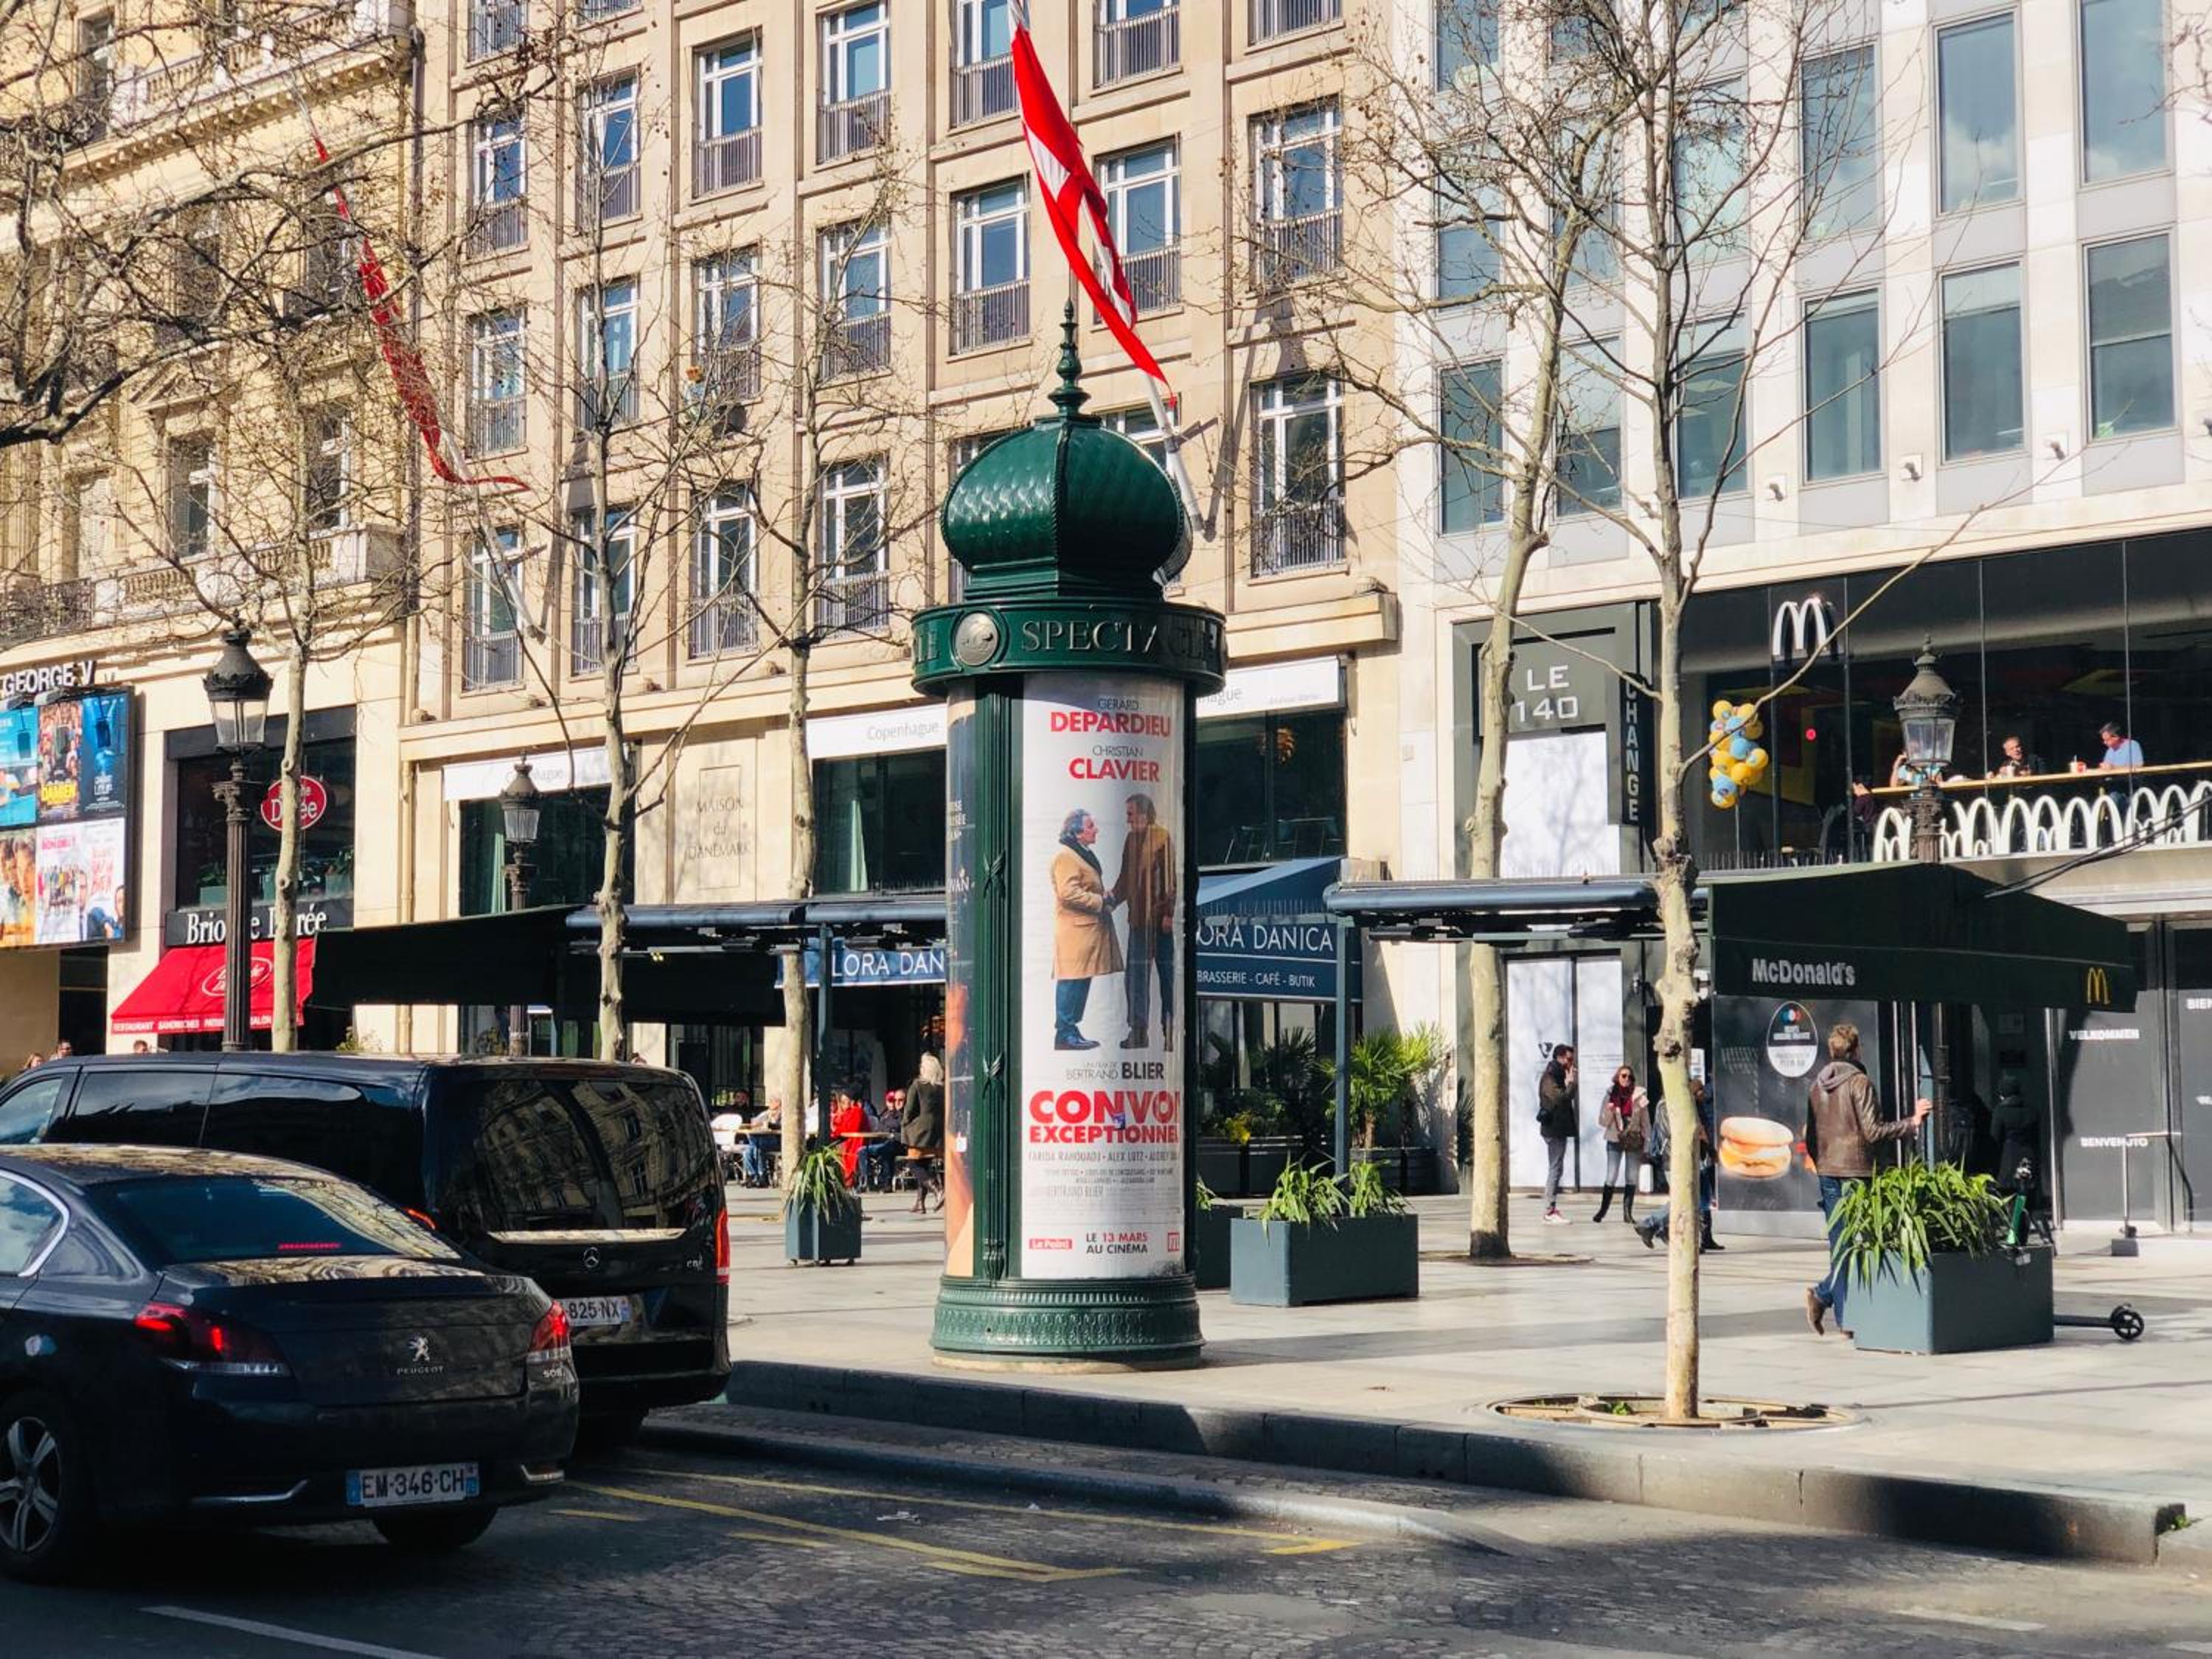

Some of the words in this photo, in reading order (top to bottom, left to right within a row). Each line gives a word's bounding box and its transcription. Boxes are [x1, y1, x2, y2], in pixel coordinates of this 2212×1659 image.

[4, 666, 74, 695] GEORGE
[81, 660, 94, 686] V
[1527, 664, 1570, 691] LE
[1512, 695, 1579, 723] 140
[866, 720, 939, 742] Copenhague
[1051, 712, 1172, 737] DEPARDIEU
[1092, 745, 1143, 757] CHRISTIAN
[1626, 678, 1640, 821] CHANGE
[1068, 757, 1161, 782] CLAVIER
[696, 796, 743, 814] MAISON
[713, 821, 726, 835] du
[186, 911, 260, 945] Brioe
[268, 903, 327, 939] rée
[1254, 925, 1334, 952] DANICA
[832, 950, 891, 978] LORA
[900, 950, 945, 975] DAN
[1752, 958, 1856, 986] McDonald's
[1197, 970, 1248, 984] BRASSERIE
[1256, 971, 1281, 986] CAFÉ
[1289, 974, 1315, 987] BUTIK
[1066, 1069, 1119, 1080] BERTRAND
[1121, 1062, 1165, 1080] BLIER
[1086, 1233, 1098, 1243] LE
[1103, 1233, 1115, 1243] 13
[1119, 1232, 1148, 1242] MARS
[1086, 1244, 1103, 1254] AU
[397, 1366, 445, 1375] PEUGEOT
[362, 1469, 465, 1500] EM-346-CH
